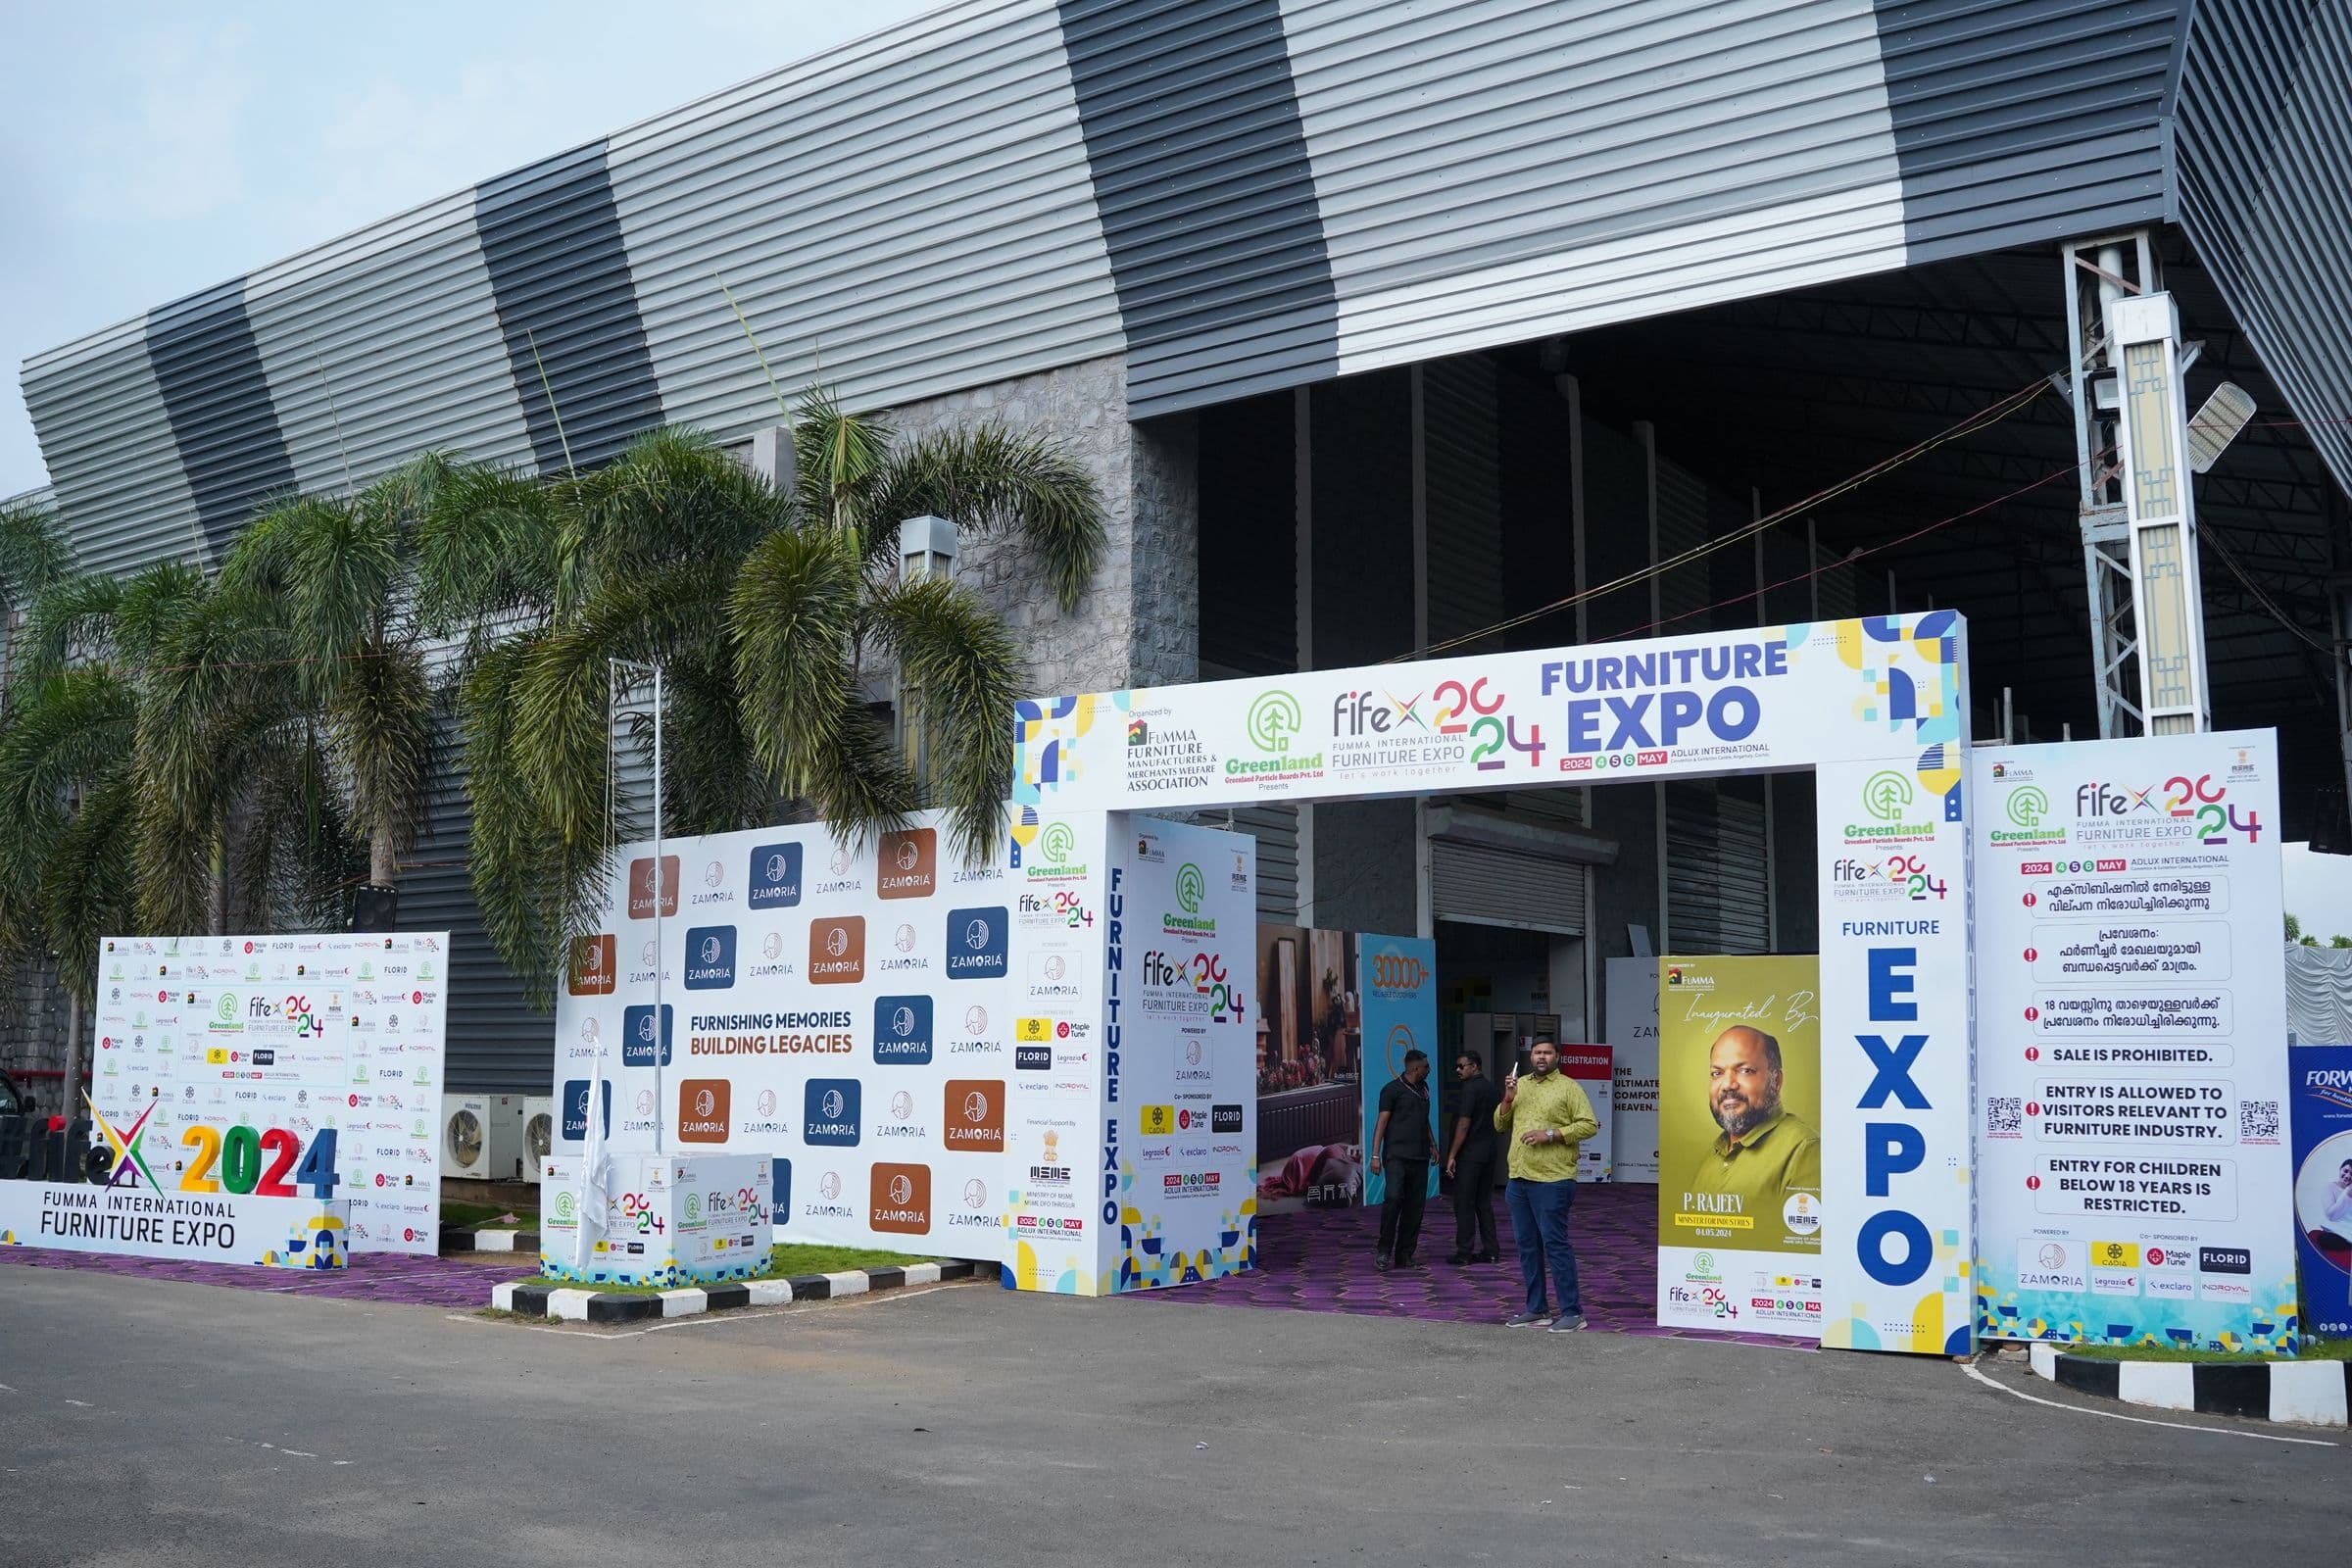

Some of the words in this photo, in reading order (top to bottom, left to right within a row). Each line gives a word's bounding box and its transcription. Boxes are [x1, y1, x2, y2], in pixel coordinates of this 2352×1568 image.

[1542, 640, 1788, 696] FURNITURE
[1128, 709, 1163, 718] Organized
[1164, 708, 1172, 717] by
[1568, 685, 1761, 753] EXPO
[1333, 742, 1371, 752] FUMMA
[1377, 734, 1464, 748] INTERNATIONAL
[1128, 743, 1202, 759] FURNITURE
[1332, 749, 1418, 768] FURNITURE
[1422, 746, 1465, 761] EXPO
[1671, 749, 1699, 758] ADLUX
[1701, 744, 1770, 756] INTERNATIONAL
[1127, 755, 1207, 768] MANUFACTURERS
[1225, 753, 1323, 774] Greenland
[1563, 759, 1592, 770] 2024
[1639, 754, 1664, 764] MAY
[1127, 769, 1177, 779] MERCHANTS
[1179, 764, 1215, 775] WELFARE
[1225, 774, 1253, 784] Greenland
[1255, 773, 1277, 782] Particle
[1314, 769, 1324, 778] Ltd
[1372, 767, 1398, 777] work
[1405, 764, 1457, 776] together
[1127, 776, 1208, 792] ASSOCIATION
[1258, 782, 1289, 791] Presents
[2116, 816, 2191, 826] INTERNATIONAL
[1844, 822, 1935, 838] Greenland
[1990, 827, 2066, 842] Greenland
[2077, 828, 2154, 841] FURNITURE
[2156, 825, 2192, 838] EXPO
[2025, 864, 2050, 873] 2024
[2099, 860, 2124, 871] MAY
[2161, 855, 2230, 864] INTERNATIONAL
[1028, 864, 1087, 876] Greenland
[816, 880, 861, 894] ZAMORIA
[882, 873, 930, 889] ZAMORIA
[692, 891, 734, 905] ZAMORIA
[753, 886, 797, 900] ZAMORIA
[1163, 913, 1215, 930] Greenland
[1842, 920, 1939, 936] FURNITURE
[813, 960, 859, 974] ZAMORIA
[881, 957, 929, 971] ZAMORIA
[952, 954, 1003, 968] ZAMORIA
[689, 967, 731, 980] ZAMORIA
[750, 964, 794, 977] ZAMORIA
[1371, 955, 1430, 988] 30000+
[1030, 986, 1078, 996] ZAMORIA
[1107, 868, 1123, 1102] FURNITURE
[1143, 1000, 1186, 1011] FURNITURE
[1189, 1002, 1208, 1012] EXPO
[1683, 993, 1775, 1034] Inaugurated
[1785, 990, 1819, 1032] By
[2044, 1001, 2055, 1010] 18
[691, 1014, 773, 1031] FURNISHING
[775, 1011, 852, 1029] MEMORIES
[691, 1036, 766, 1055] BUILDING
[769, 1033, 853, 1054] LEGACIES
[878, 1041, 927, 1054] ZAMORIA
[951, 1041, 1002, 1054] ZAMORIA
[1018, 1052, 1049, 1061] FLORID
[2053, 1049, 2091, 1061] SALE
[2094, 1049, 2108, 1061] IS
[2111, 1049, 2214, 1062] PROHIBITED.
[1176, 1071, 1210, 1080] ZAMORIA
[2045, 1086, 2096, 1099] ENTRY
[2100, 1087, 2114, 1099] IS
[2118, 1087, 2196, 1100] ALLOWED
[2199, 1088, 2223, 1101] TO
[1191, 1111, 1207, 1120] Maple
[1214, 1110, 1241, 1122] FLORID
[1854, 947, 1934, 1287] EXPO
[2042, 1103, 2116, 1117] VISITORS
[2118, 1104, 2203, 1119] RELEVANT
[2205, 1106, 2228, 1120] TO
[683, 1121, 725, 1133] ZAMORIA
[744, 1121, 788, 1134] ZAMORIA
[808, 1123, 856, 1137] ZAMORIA
[877, 1125, 926, 1139] ZAMORIA
[949, 1127, 1002, 1141] ZAMORIA
[2043, 1122, 2131, 1137] FURNITURE
[2134, 1124, 2224, 1139] INDUSTRY.
[180, 1125, 340, 1200] 2024
[2049, 1159, 2100, 1174] ENTRY
[2104, 1161, 2136, 1174] FOR
[2138, 1161, 2221, 1177] CHILDREN
[1103, 1119, 1119, 1225] EXPO
[2060, 1178, 2116, 1193] BELOW
[2119, 1180, 2134, 1193] 18
[2138, 1181, 2192, 1195] YEARS
[2195, 1182, 2211, 1196] IS
[44, 1192, 97, 1209] FUMMA
[108, 1197, 236, 1218] INTERNATIONAL
[806, 1205, 853, 1218] ZAMORIA
[2083, 1198, 2185, 1214] RESTRICTED.
[874, 1208, 925, 1224] ZAMORIA
[949, 1214, 1002, 1228] ZAMORIA
[1678, 1215, 1703, 1224] MINISTER
[41, 1211, 163, 1244] FURNITURE
[173, 1221, 235, 1249] EXPO
[2165, 1249, 2192, 1261] Maple
[2166, 1257, 2186, 1267] Tune
[2202, 1252, 2247, 1265] FLORID
[2020, 1273, 2083, 1287] ZAMORIA
[2159, 1281, 2192, 1292] exclaro
